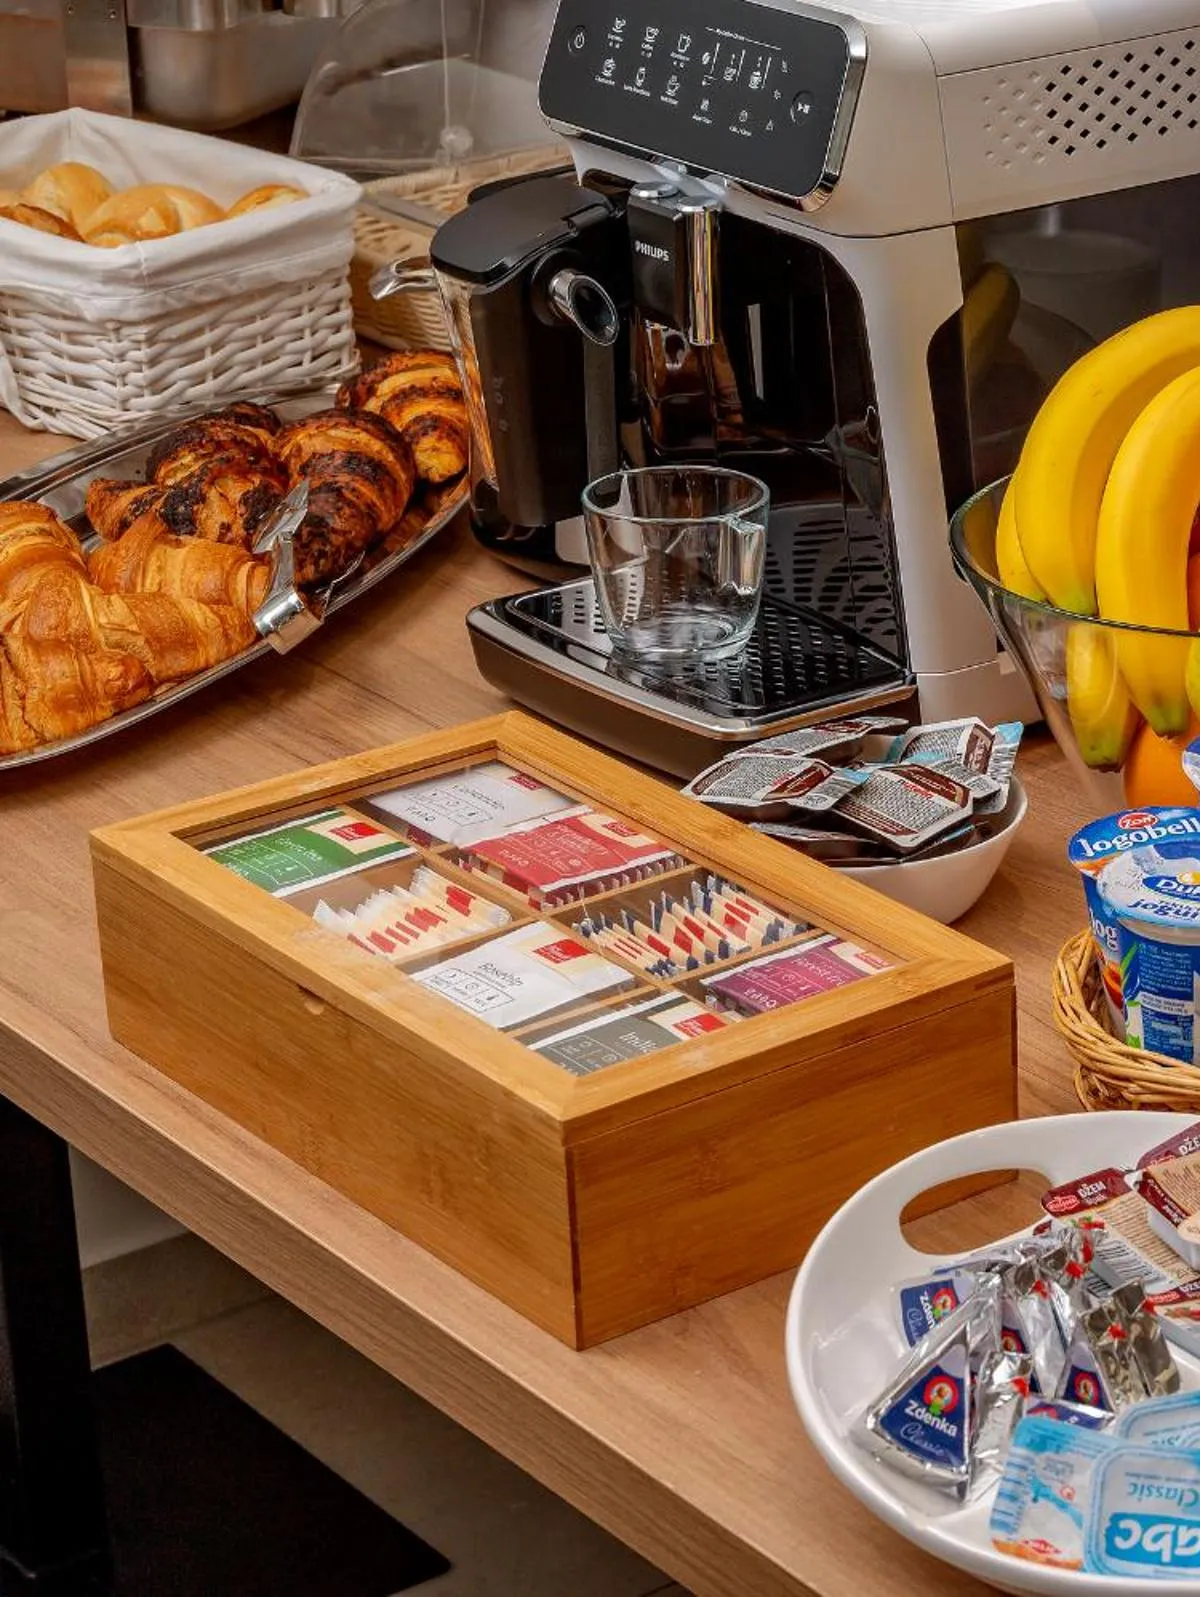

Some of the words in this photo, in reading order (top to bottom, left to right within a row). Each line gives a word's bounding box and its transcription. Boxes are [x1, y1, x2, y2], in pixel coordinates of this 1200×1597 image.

[634, 240, 670, 261] PHILIPS
[1077, 1180, 1107, 1200] DŽEM
[903, 1399, 959, 1438] Zdenka
[1126, 1482, 1200, 1509] Classic
